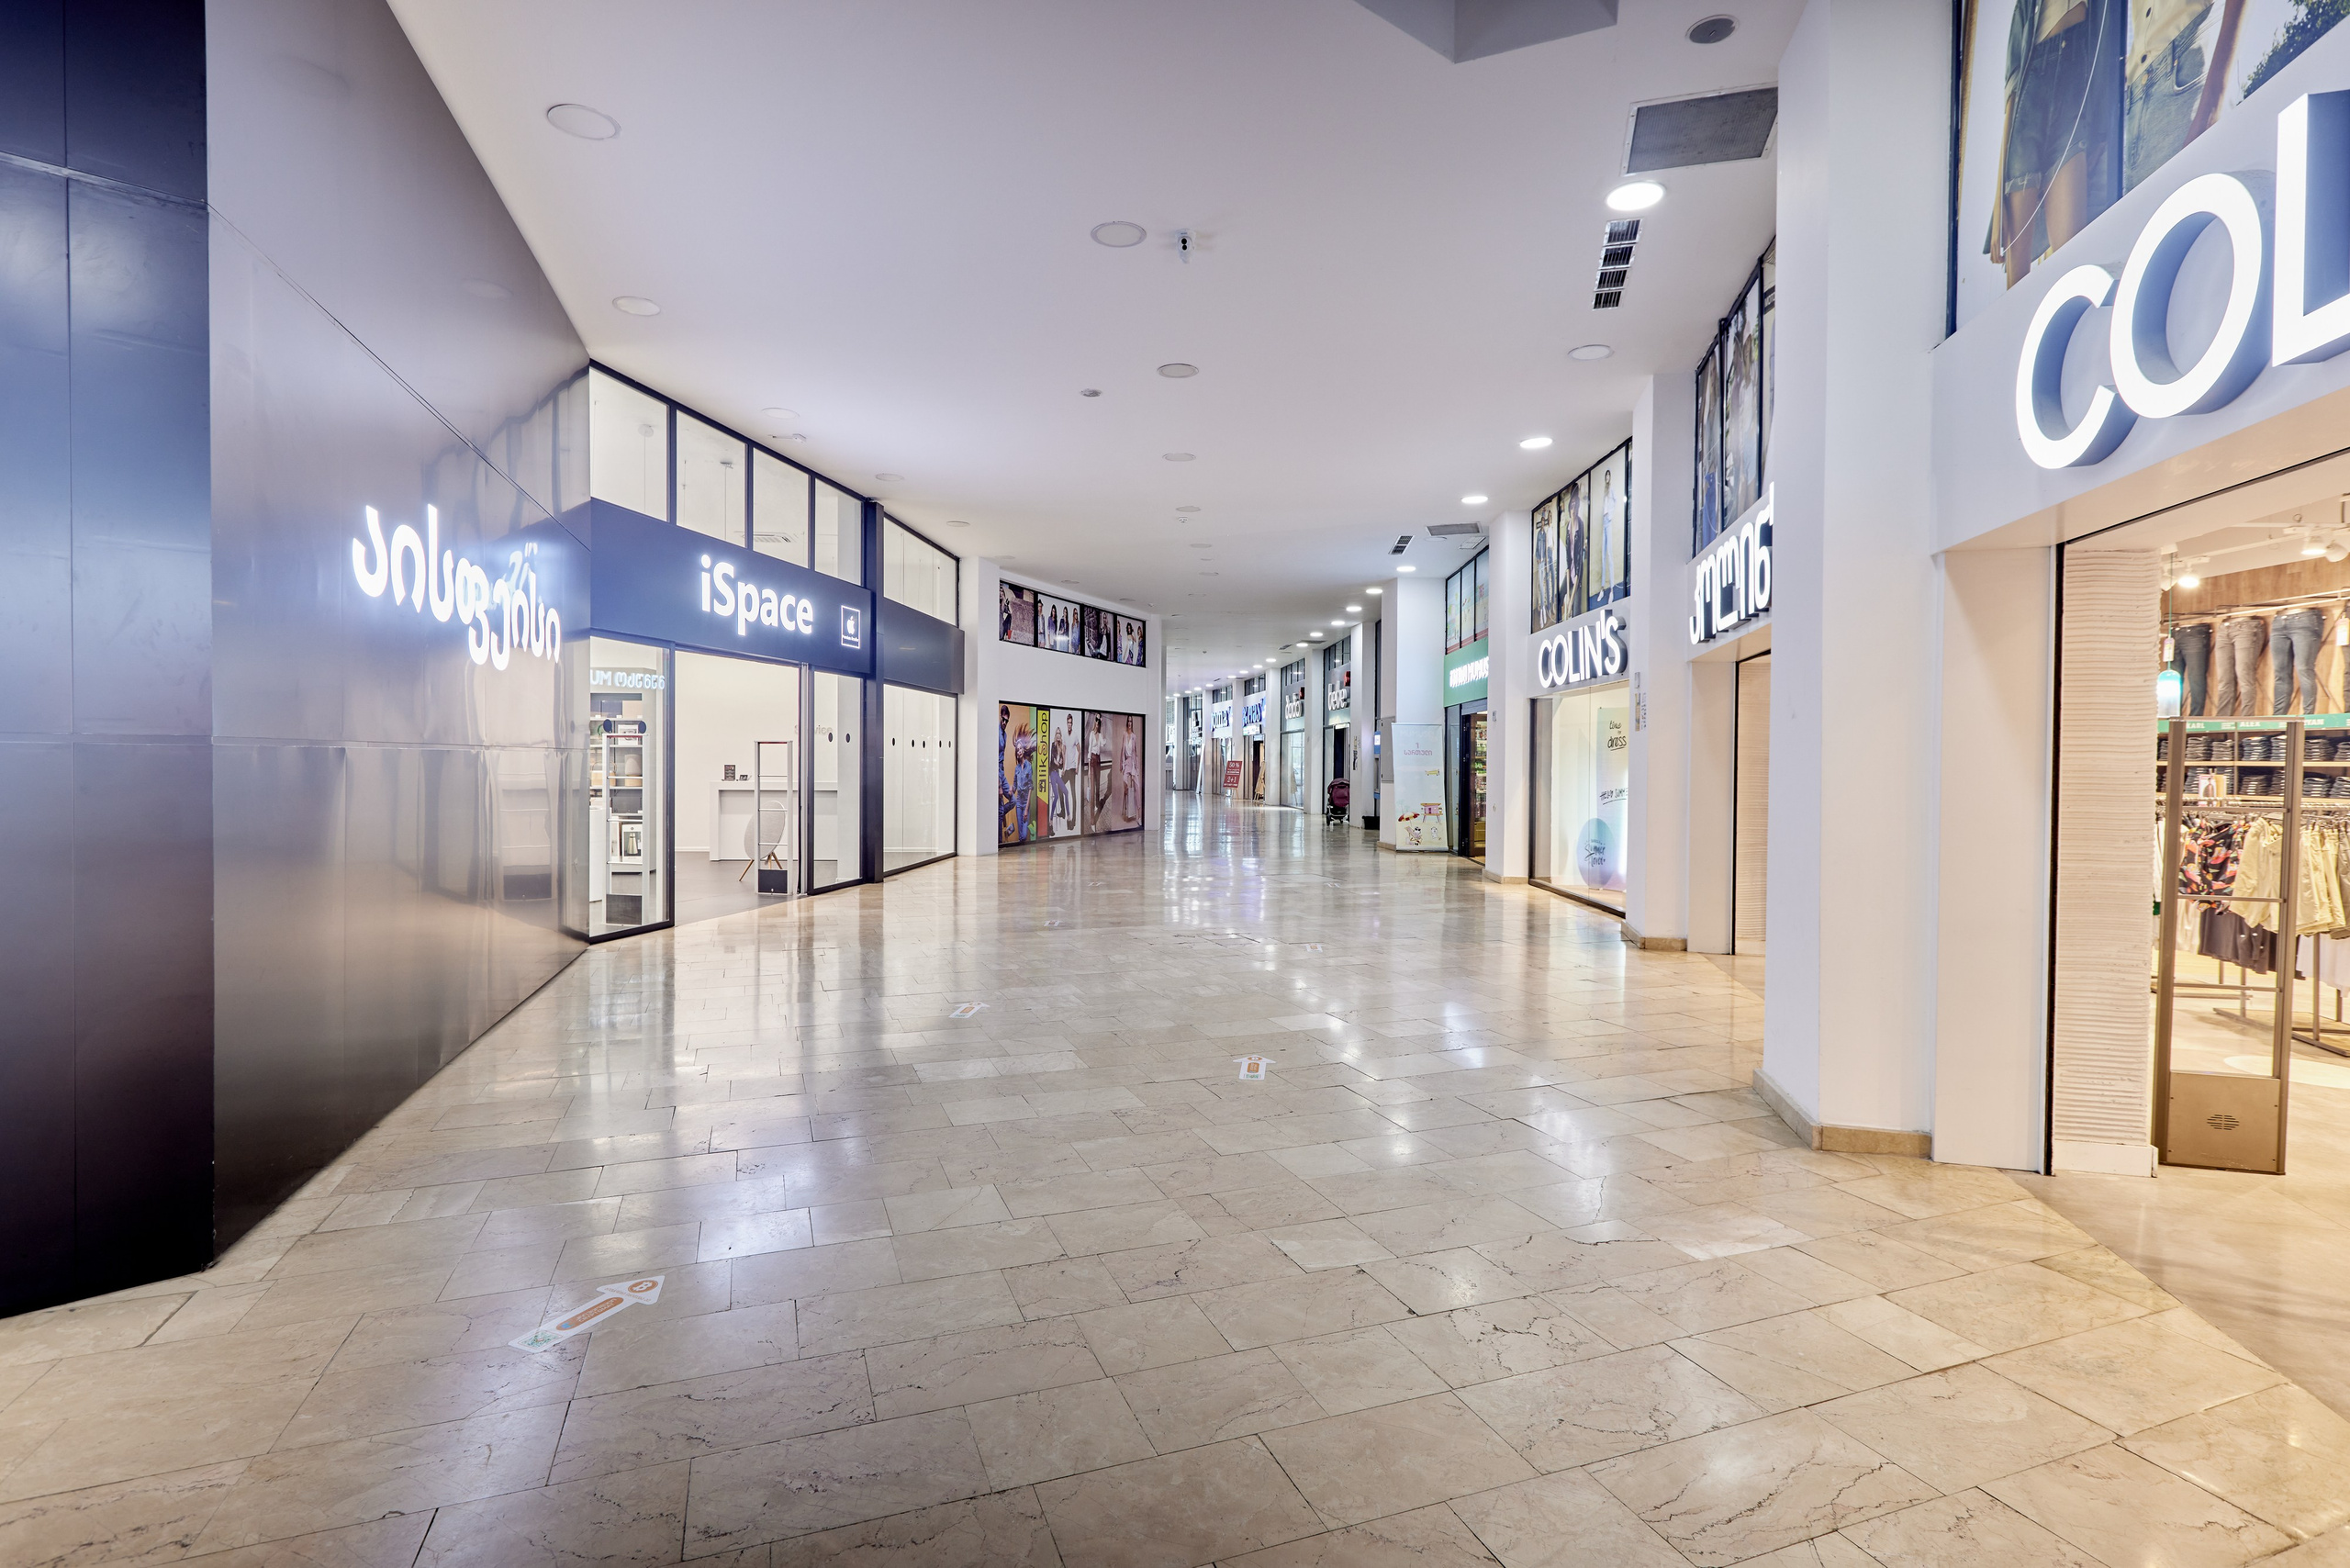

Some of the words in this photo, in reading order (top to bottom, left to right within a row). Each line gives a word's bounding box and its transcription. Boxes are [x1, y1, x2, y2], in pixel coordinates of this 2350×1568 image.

[2016, 93, 2350, 469] COL
[700, 554, 814, 635] iSpace
[1538, 609, 1623, 689] COLIN'S
[1327, 680, 1348, 711] bebe
[1606, 735, 1627, 748] dress
